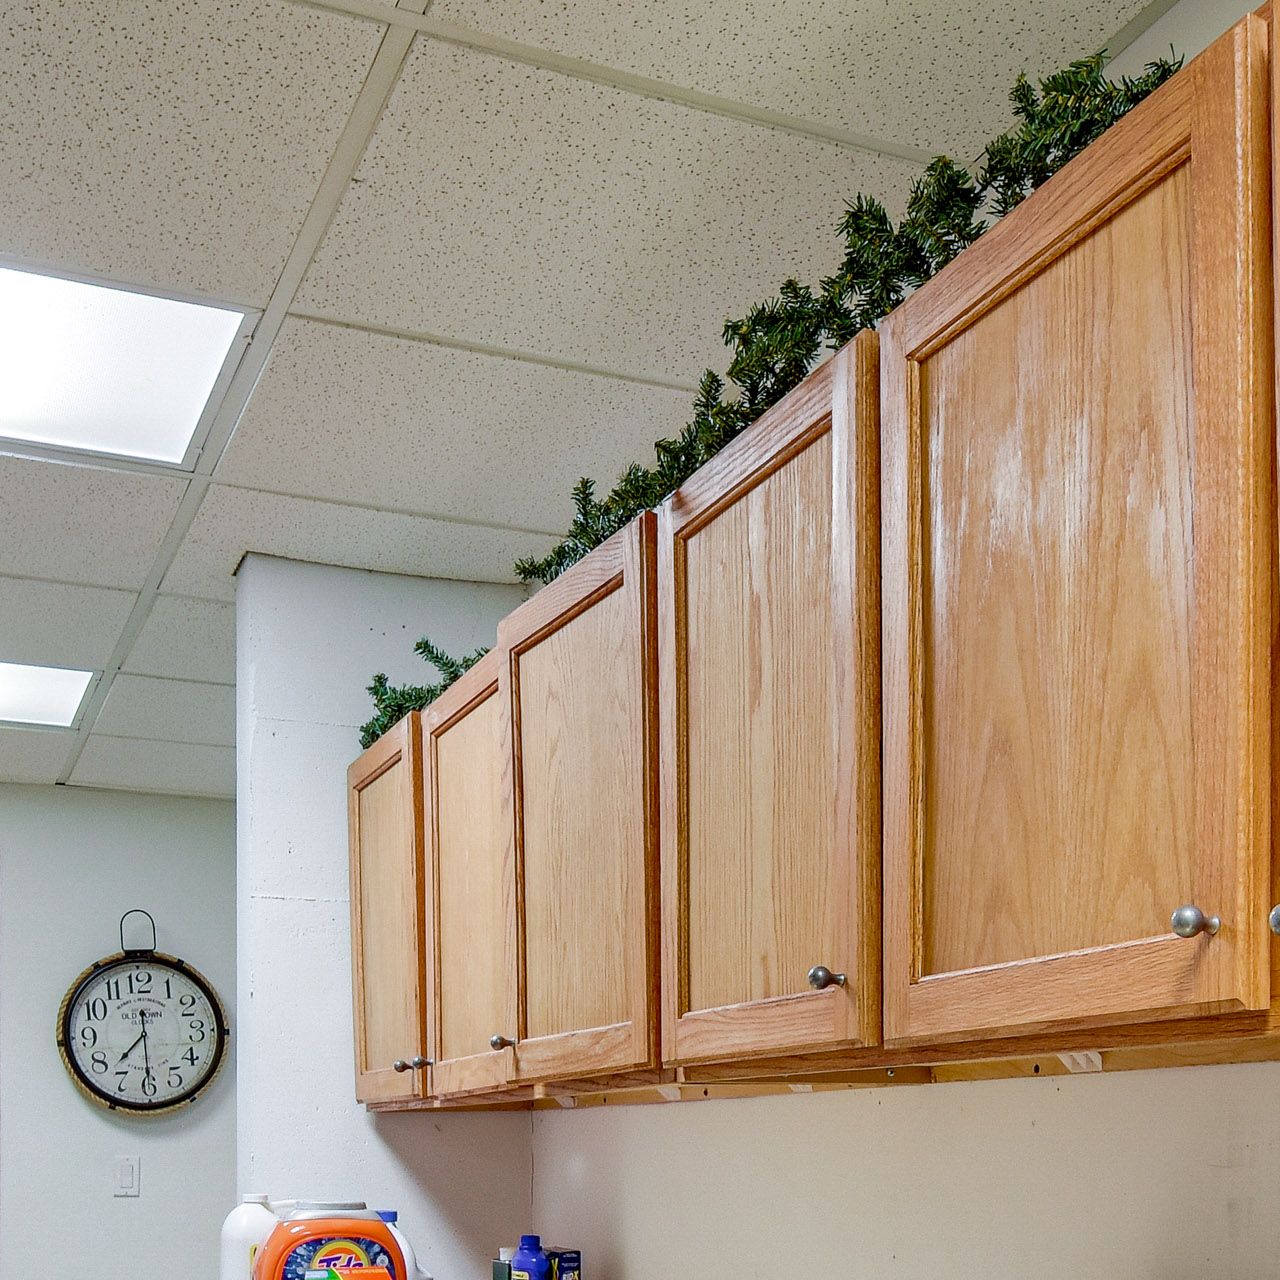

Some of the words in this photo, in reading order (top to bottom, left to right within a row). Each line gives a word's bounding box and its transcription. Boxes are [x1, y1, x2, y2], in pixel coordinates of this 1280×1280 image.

[105, 979, 122, 1000] 11
[127, 971, 153, 994] 12
[164, 978, 172, 999] 1
[84, 998, 107, 1021] 10
[179, 994, 197, 1017] 2
[80, 1026, 98, 1048] 9
[189, 1019, 205, 1043] 3
[91, 1051, 109, 1074] 8
[181, 1046, 199, 1066] 4
[115, 1071, 129, 1093] 7
[141, 1074, 157, 1097] 6
[167, 1066, 183, 1089] 5
[318, 1254, 364, 1268] Td
